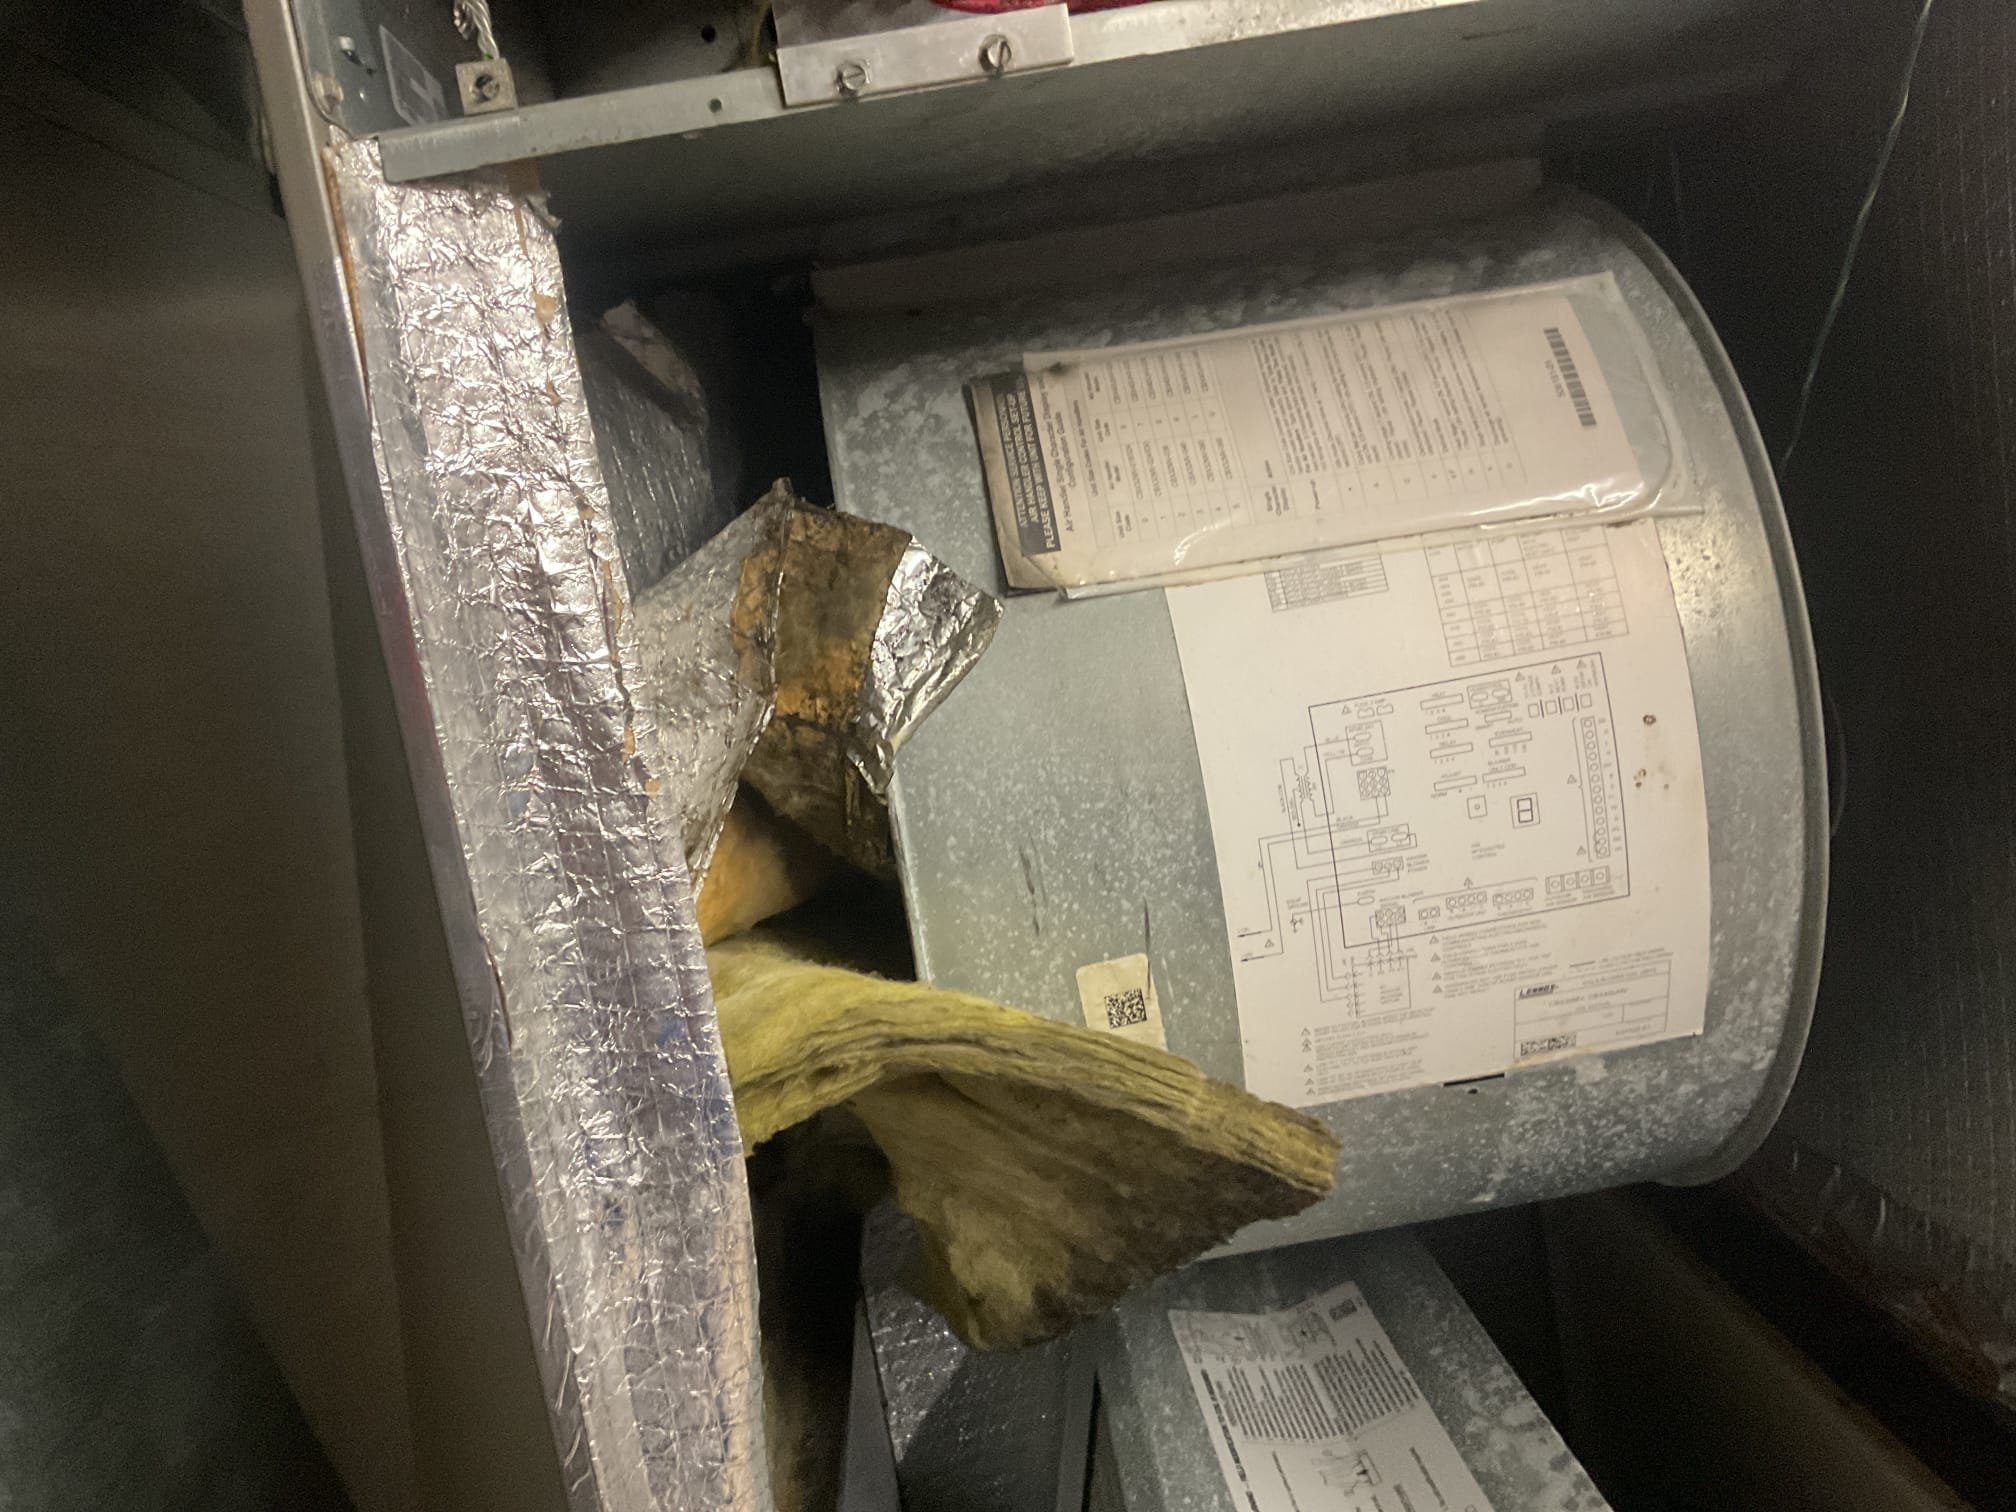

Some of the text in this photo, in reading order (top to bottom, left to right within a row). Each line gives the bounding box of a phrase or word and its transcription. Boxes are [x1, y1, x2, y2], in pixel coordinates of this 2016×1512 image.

[1006, 392, 1020, 422] SET-UP
[1016, 390, 1031, 422] FUTURE
[1039, 390, 1053, 419] Display
[1012, 424, 1028, 463] CONTROL
[1023, 423, 1034, 441] FOR
[1044, 420, 1059, 458] Character
[1004, 442, 1018, 476] SERVICE
[1027, 442, 1038, 461] UNIT
[1053, 411, 1078, 488] Configuration Guide
[1020, 464, 1036, 504] HANDLER
[1031, 462, 1042, 483] WITH
[1052, 458, 1066, 483] Single
[1011, 477, 1028, 528] ATTENTION
[1035, 484, 1048, 508] KEEP
[1057, 484, 1070, 517] Handler
[1028, 505, 1039, 523] AIR
[1040, 511, 1055, 548] PLEASE
[1064, 518, 1073, 532] Air
